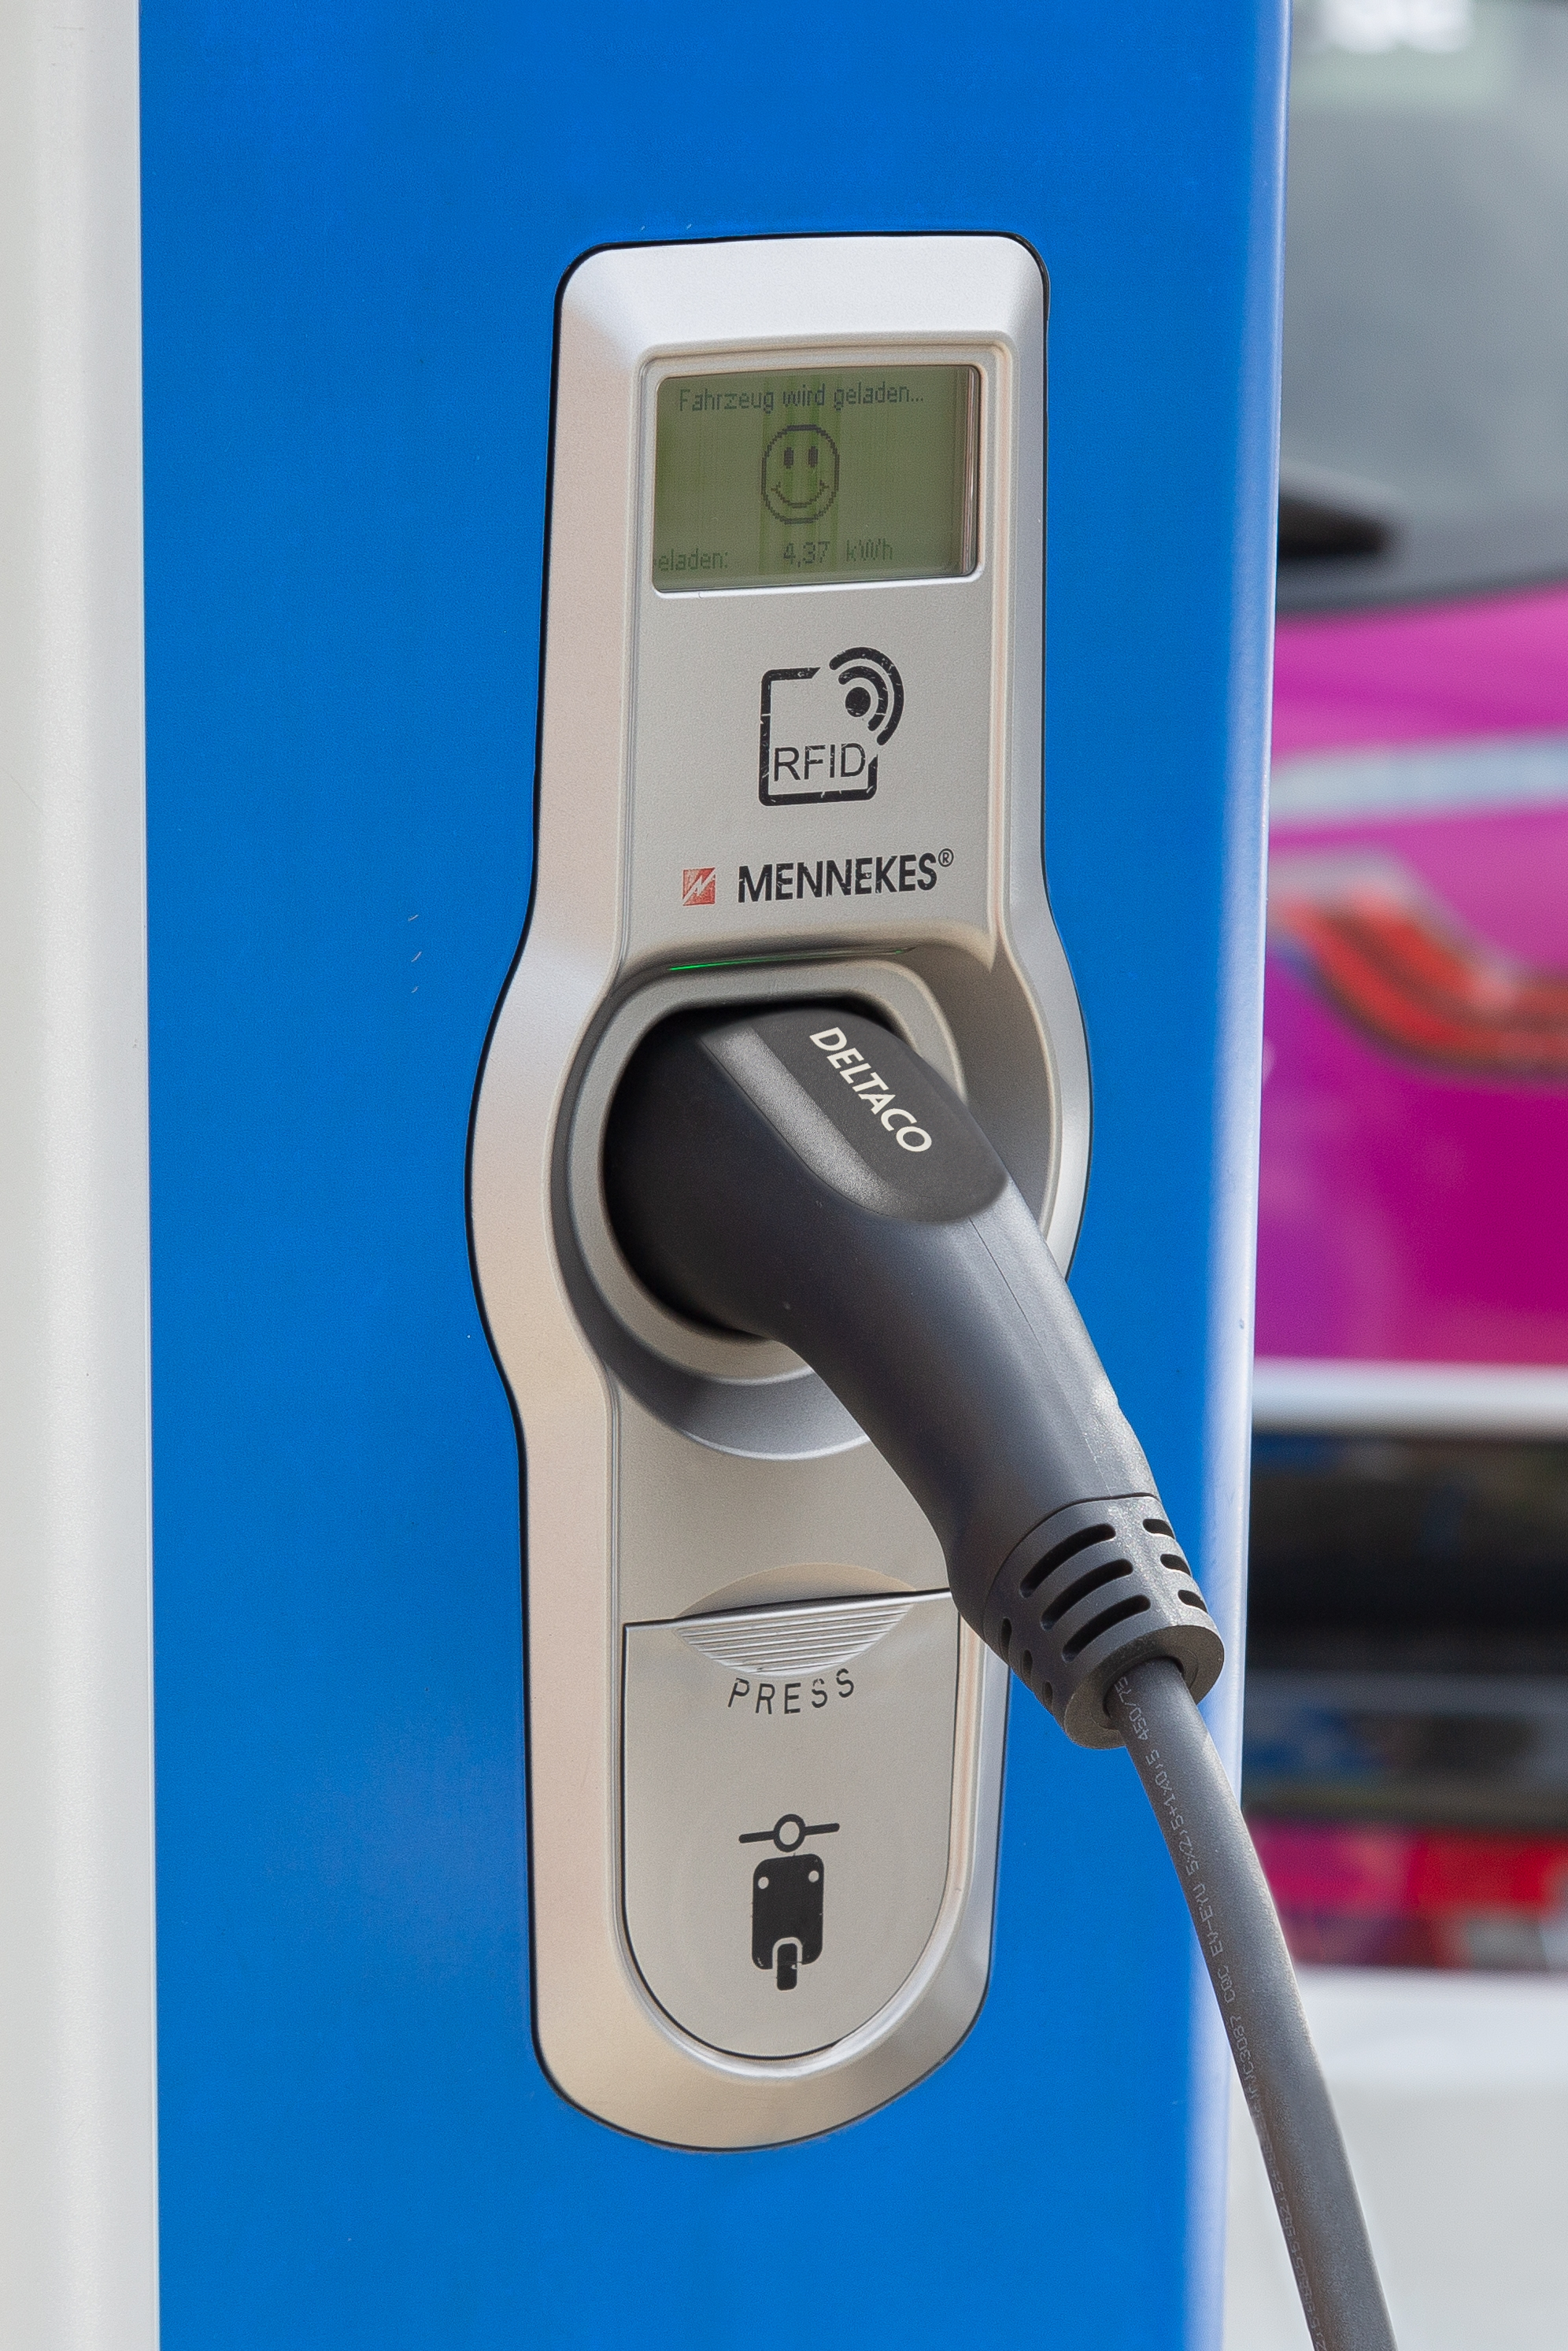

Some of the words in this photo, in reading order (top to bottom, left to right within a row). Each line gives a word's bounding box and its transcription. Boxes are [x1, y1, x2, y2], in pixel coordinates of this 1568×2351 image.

[679, 386, 774, 414] Fahrzeug
[782, 383, 826, 408] wird
[653, 548, 728, 571] eladen:
[783, 541, 830, 567] 4,37
[845, 538, 893, 562] kWh
[773, 742, 867, 782] RFID
[809, 1027, 932, 1152] DELTACO
[727, 1668, 855, 1715] PRESS
